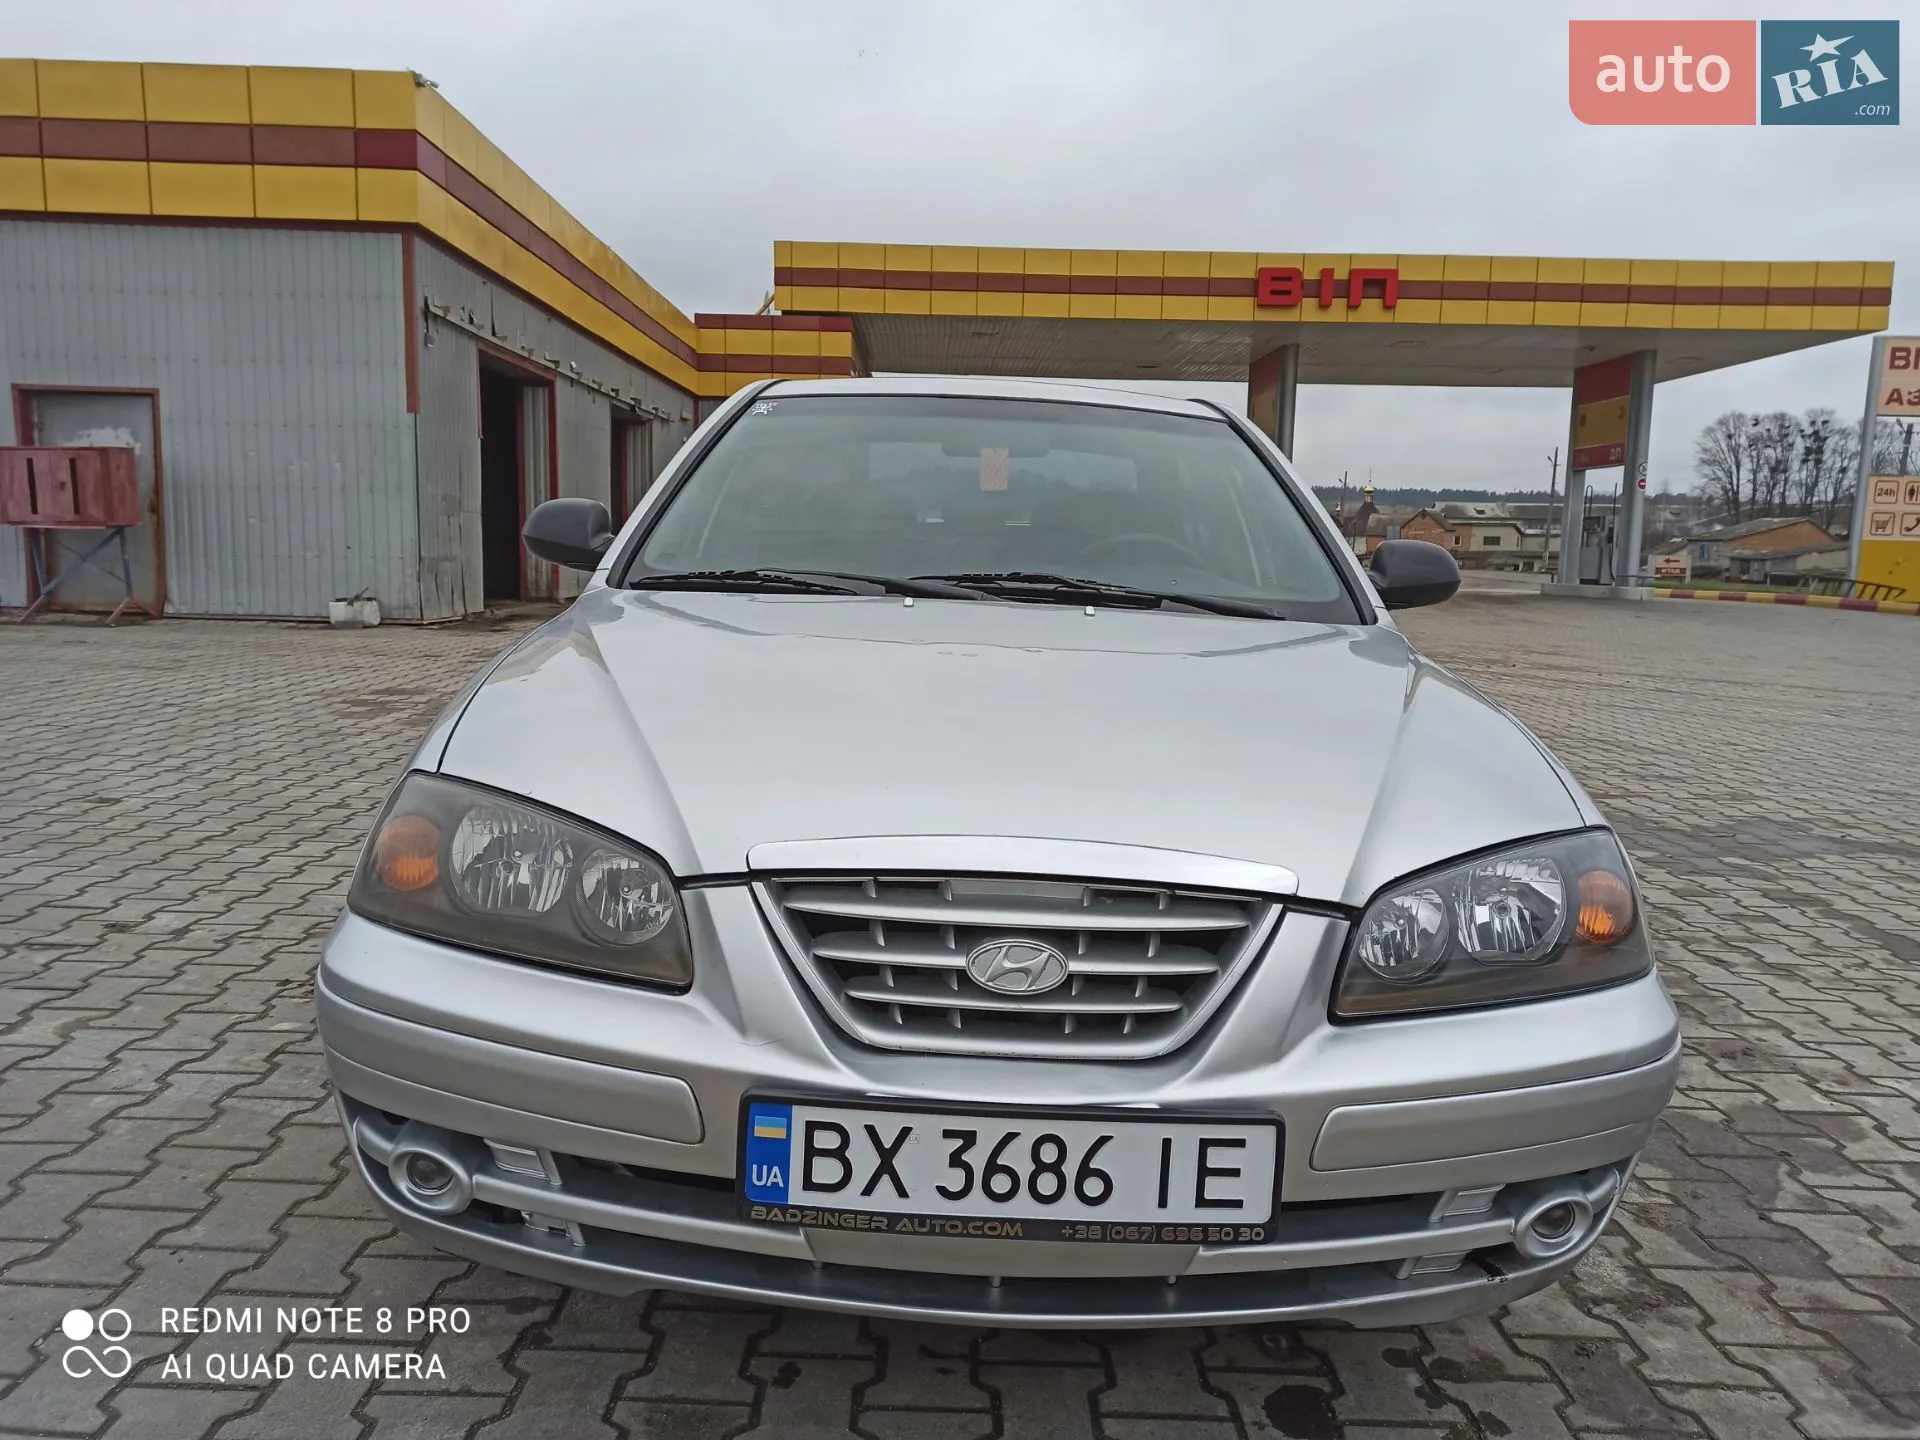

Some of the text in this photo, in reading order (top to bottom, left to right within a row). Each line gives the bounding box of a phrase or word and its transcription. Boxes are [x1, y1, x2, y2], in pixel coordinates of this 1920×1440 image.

[1876, 487, 1896, 497] 24h
[752, 1164, 784, 1188] UA
[802, 1120, 1247, 1208] BX 3686 IE
[750, 1206, 1024, 1237] BADZINGER AUTO.COM
[1061, 1224, 1265, 1242] +38 (067) 696 50 30
